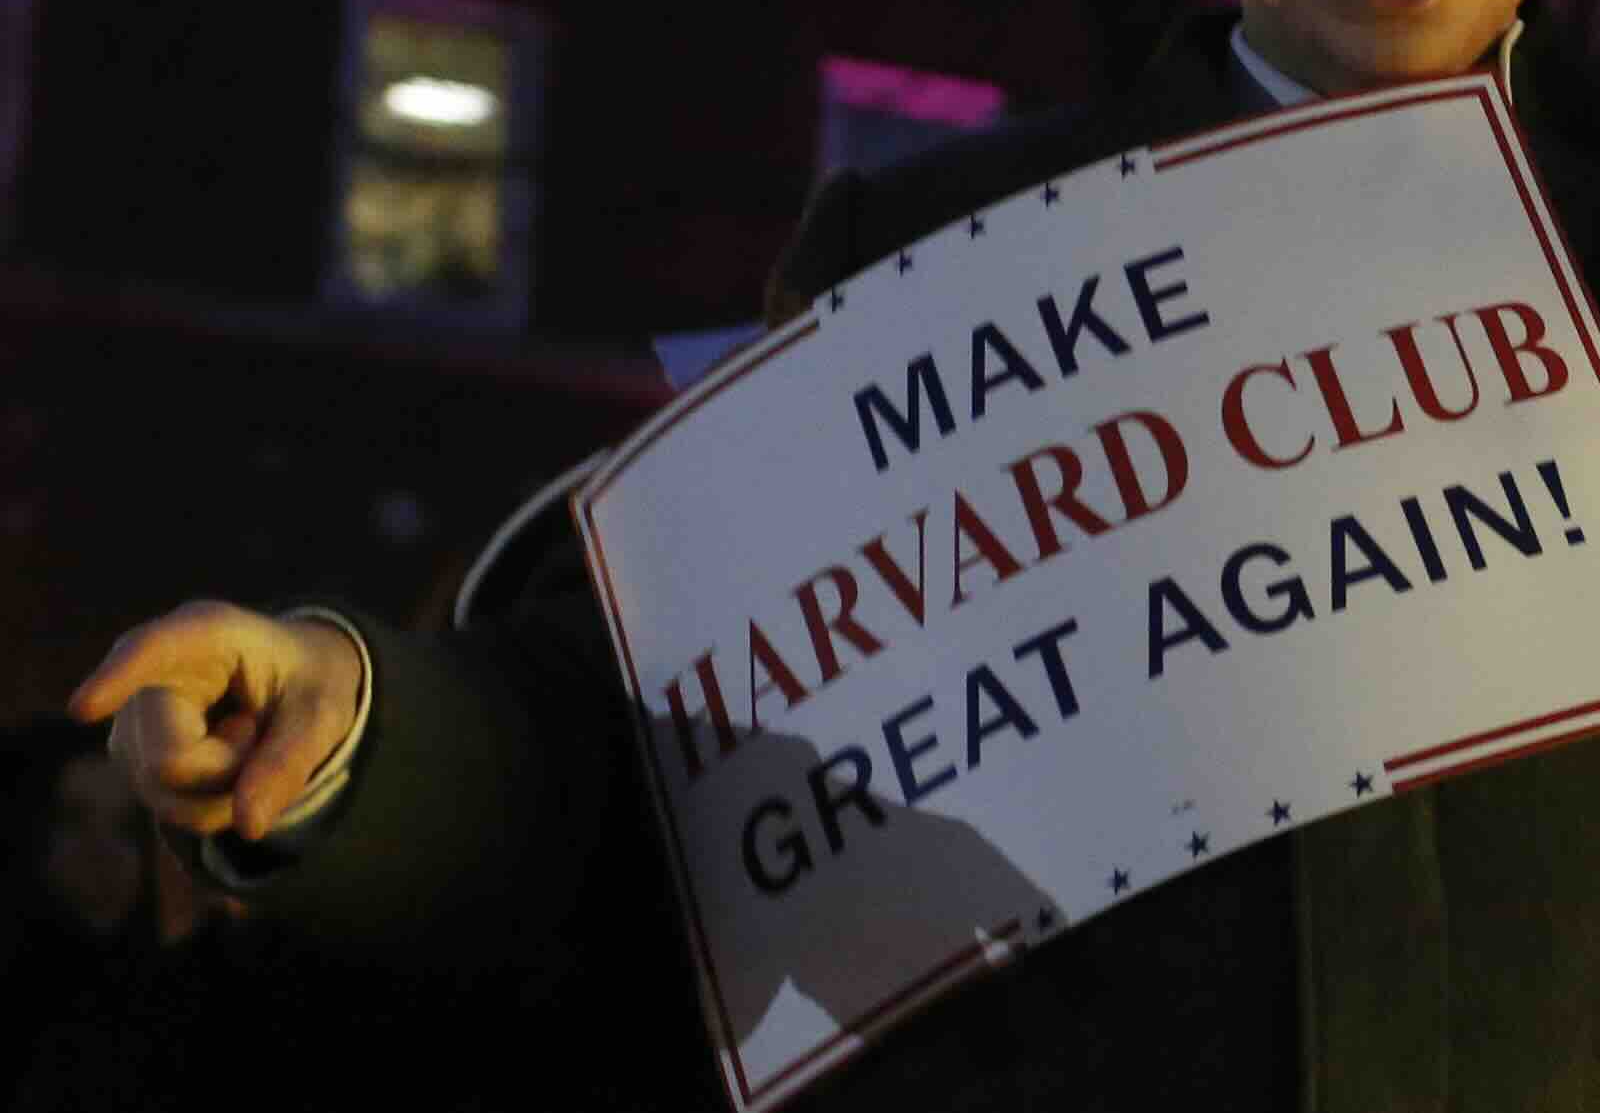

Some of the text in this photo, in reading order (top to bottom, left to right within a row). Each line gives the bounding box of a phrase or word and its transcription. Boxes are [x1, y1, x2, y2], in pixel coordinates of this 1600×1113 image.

[664, 301, 1570, 780] HARVARD CLUB
[854, 247, 1209, 471] MAKE
[741, 460, 1585, 897] GREAT AGAIN!
